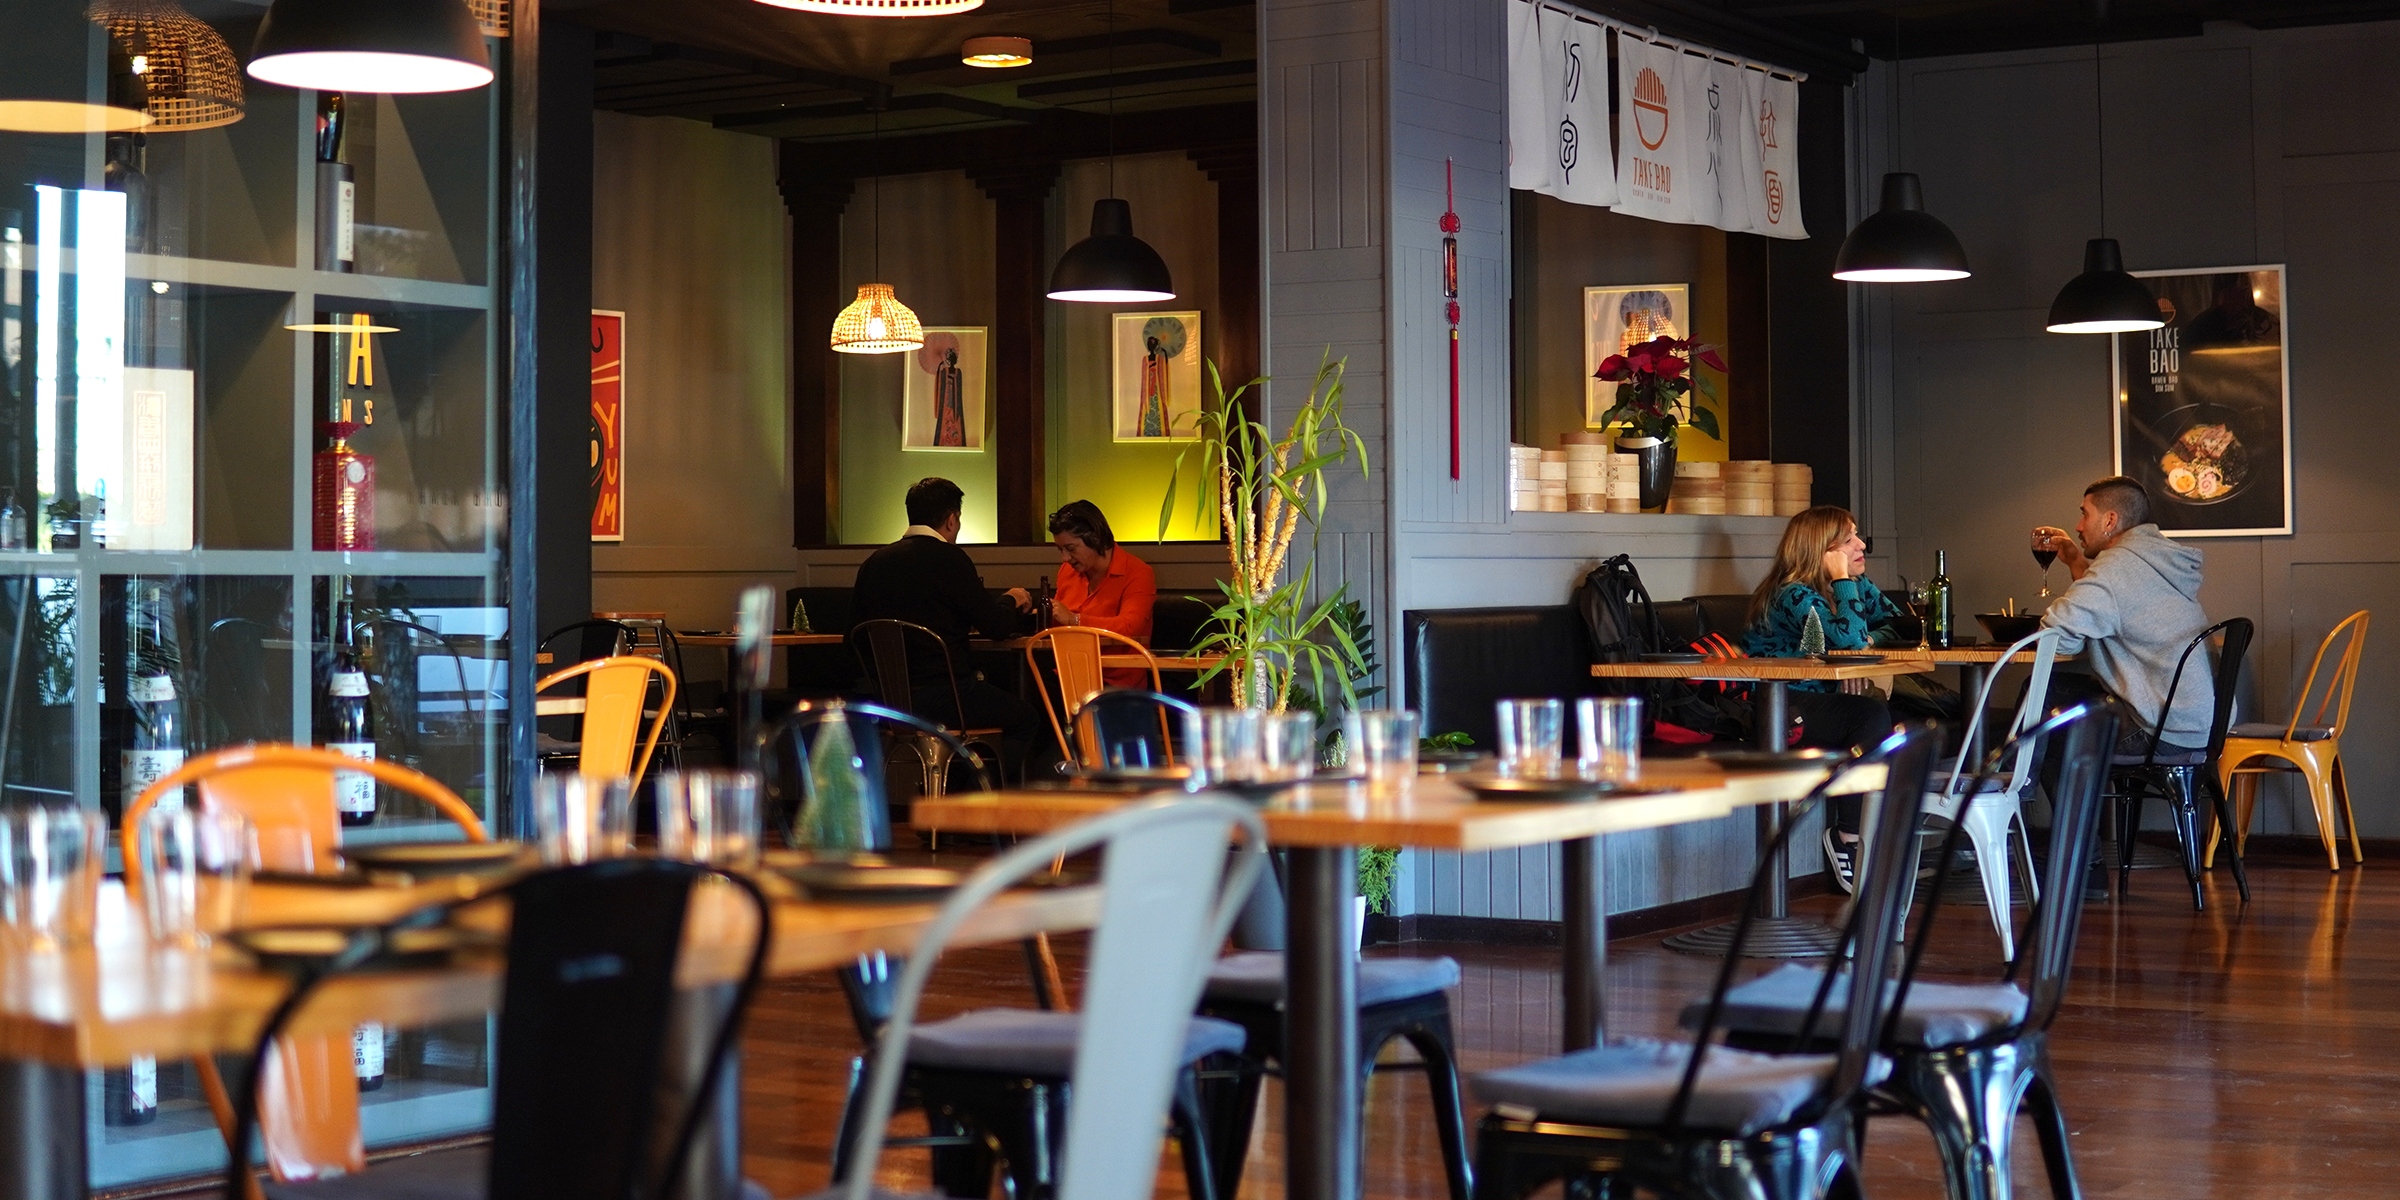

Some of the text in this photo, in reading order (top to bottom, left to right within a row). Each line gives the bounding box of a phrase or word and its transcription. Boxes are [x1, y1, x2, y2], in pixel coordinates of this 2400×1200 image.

[1633, 157, 1671, 193] TAKE BAO
[2149, 327, 2179, 349] TAKE
[2150, 349, 2179, 374] BAO
